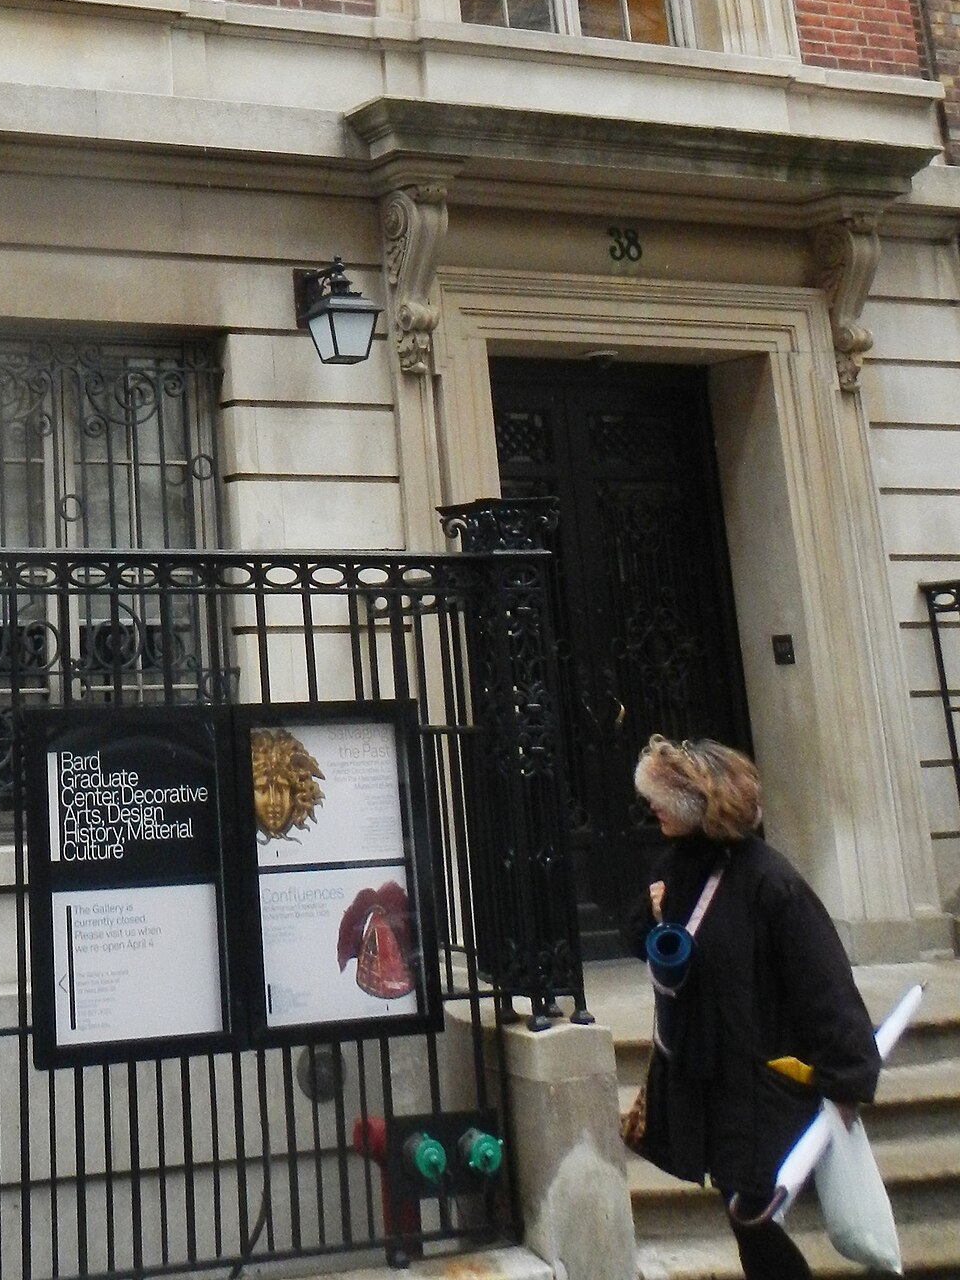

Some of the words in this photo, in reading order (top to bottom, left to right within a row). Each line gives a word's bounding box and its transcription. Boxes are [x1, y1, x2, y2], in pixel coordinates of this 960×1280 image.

[607, 226, 642, 262] 38
[339, 744, 361, 758] the
[362, 743, 390, 758] Past
[61, 751, 101, 771] Bard
[61, 769, 139, 788] Graduate
[121, 784, 209, 805] Decorative
[63, 806, 106, 826] Arts,
[107, 804, 165, 827] Design
[63, 820, 125, 844] History,
[127, 817, 194, 840] Material
[62, 840, 124, 861] Culture
[260, 887, 345, 903] Confluences
[73, 905, 92, 915] The
[92, 903, 123, 914] Gallery
[73, 917, 114, 928] currently
[73, 929, 104, 940] Please
[138, 926, 162, 937] when
